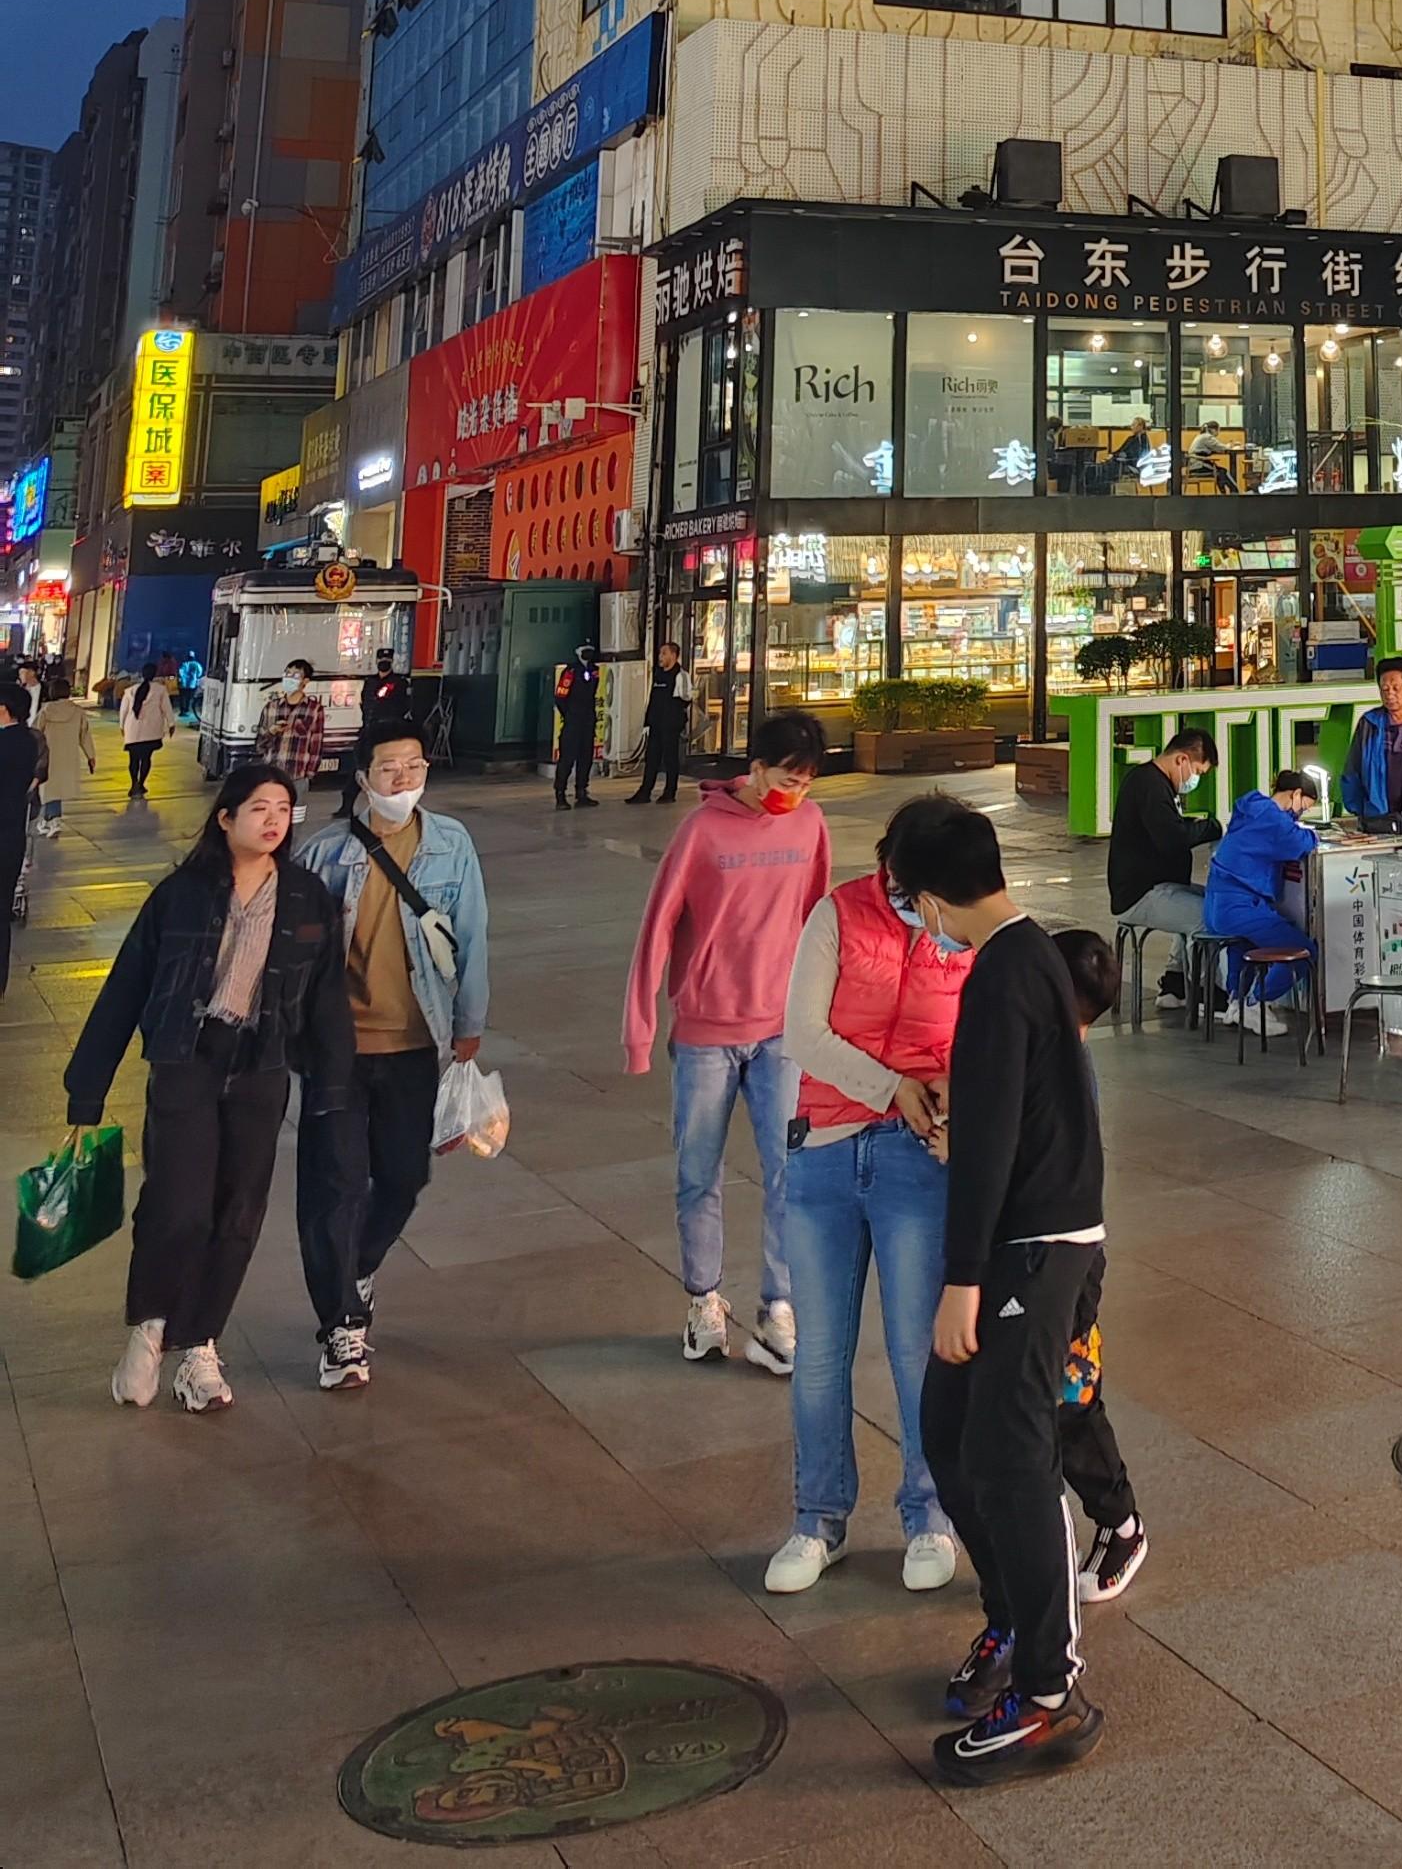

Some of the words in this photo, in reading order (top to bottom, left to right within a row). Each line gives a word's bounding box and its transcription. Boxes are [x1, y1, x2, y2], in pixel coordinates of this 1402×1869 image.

[656, 238, 744, 326] 丽驰烘焙
[1000, 291, 1118, 310] TAIDONG
[1134, 295, 1286, 316] PEDESTRIAN
[1300, 301, 1385, 319] STREET
[794, 364, 875, 403] Rich
[144, 360, 178, 454] 医保城
[689, 515, 717, 536] BAKERY
